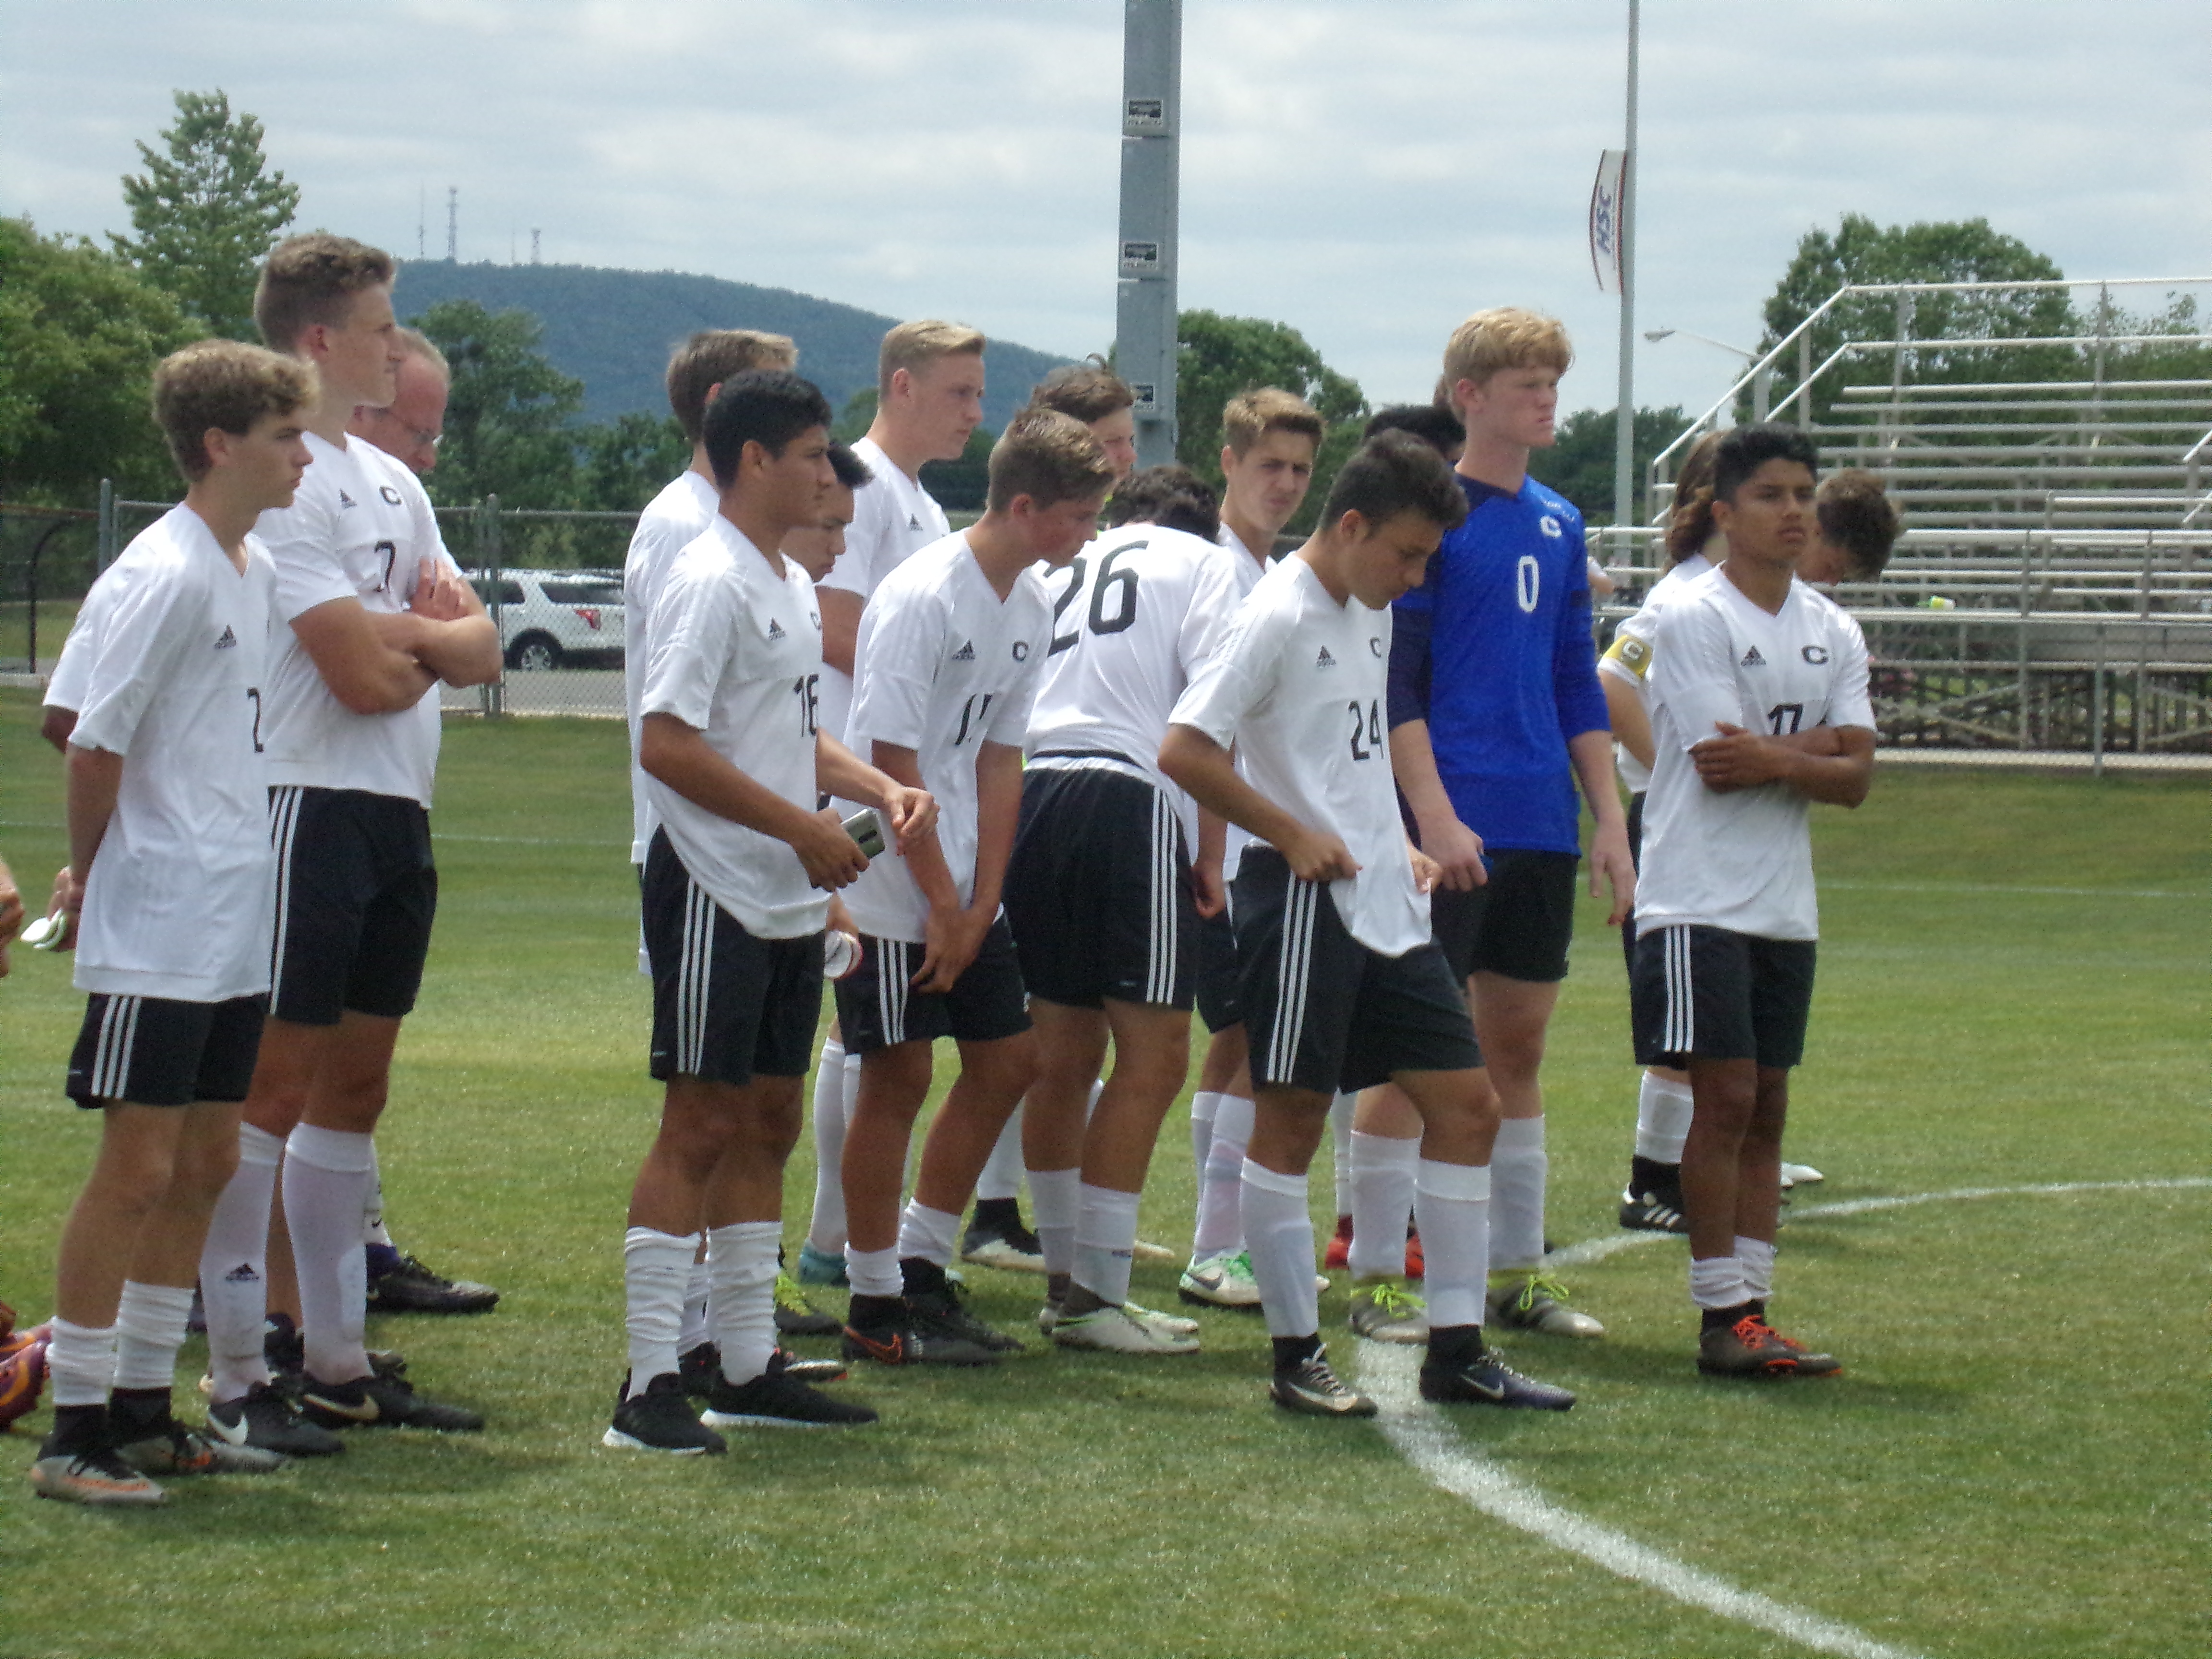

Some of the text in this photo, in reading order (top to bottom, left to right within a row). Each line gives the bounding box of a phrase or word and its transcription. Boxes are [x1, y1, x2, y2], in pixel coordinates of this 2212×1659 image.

[1596, 184, 1611, 254] HSC
[379, 486, 402, 505] C
[1539, 515, 1562, 537] C
[1518, 555, 1539, 612] 0
[1043, 540, 1150, 658] 26
[1012, 640, 1029, 661] C
[1369, 636, 1382, 658] C
[1801, 645, 1828, 665] C
[1348, 699, 1384, 760] 24
[1767, 703, 1803, 735] 17
